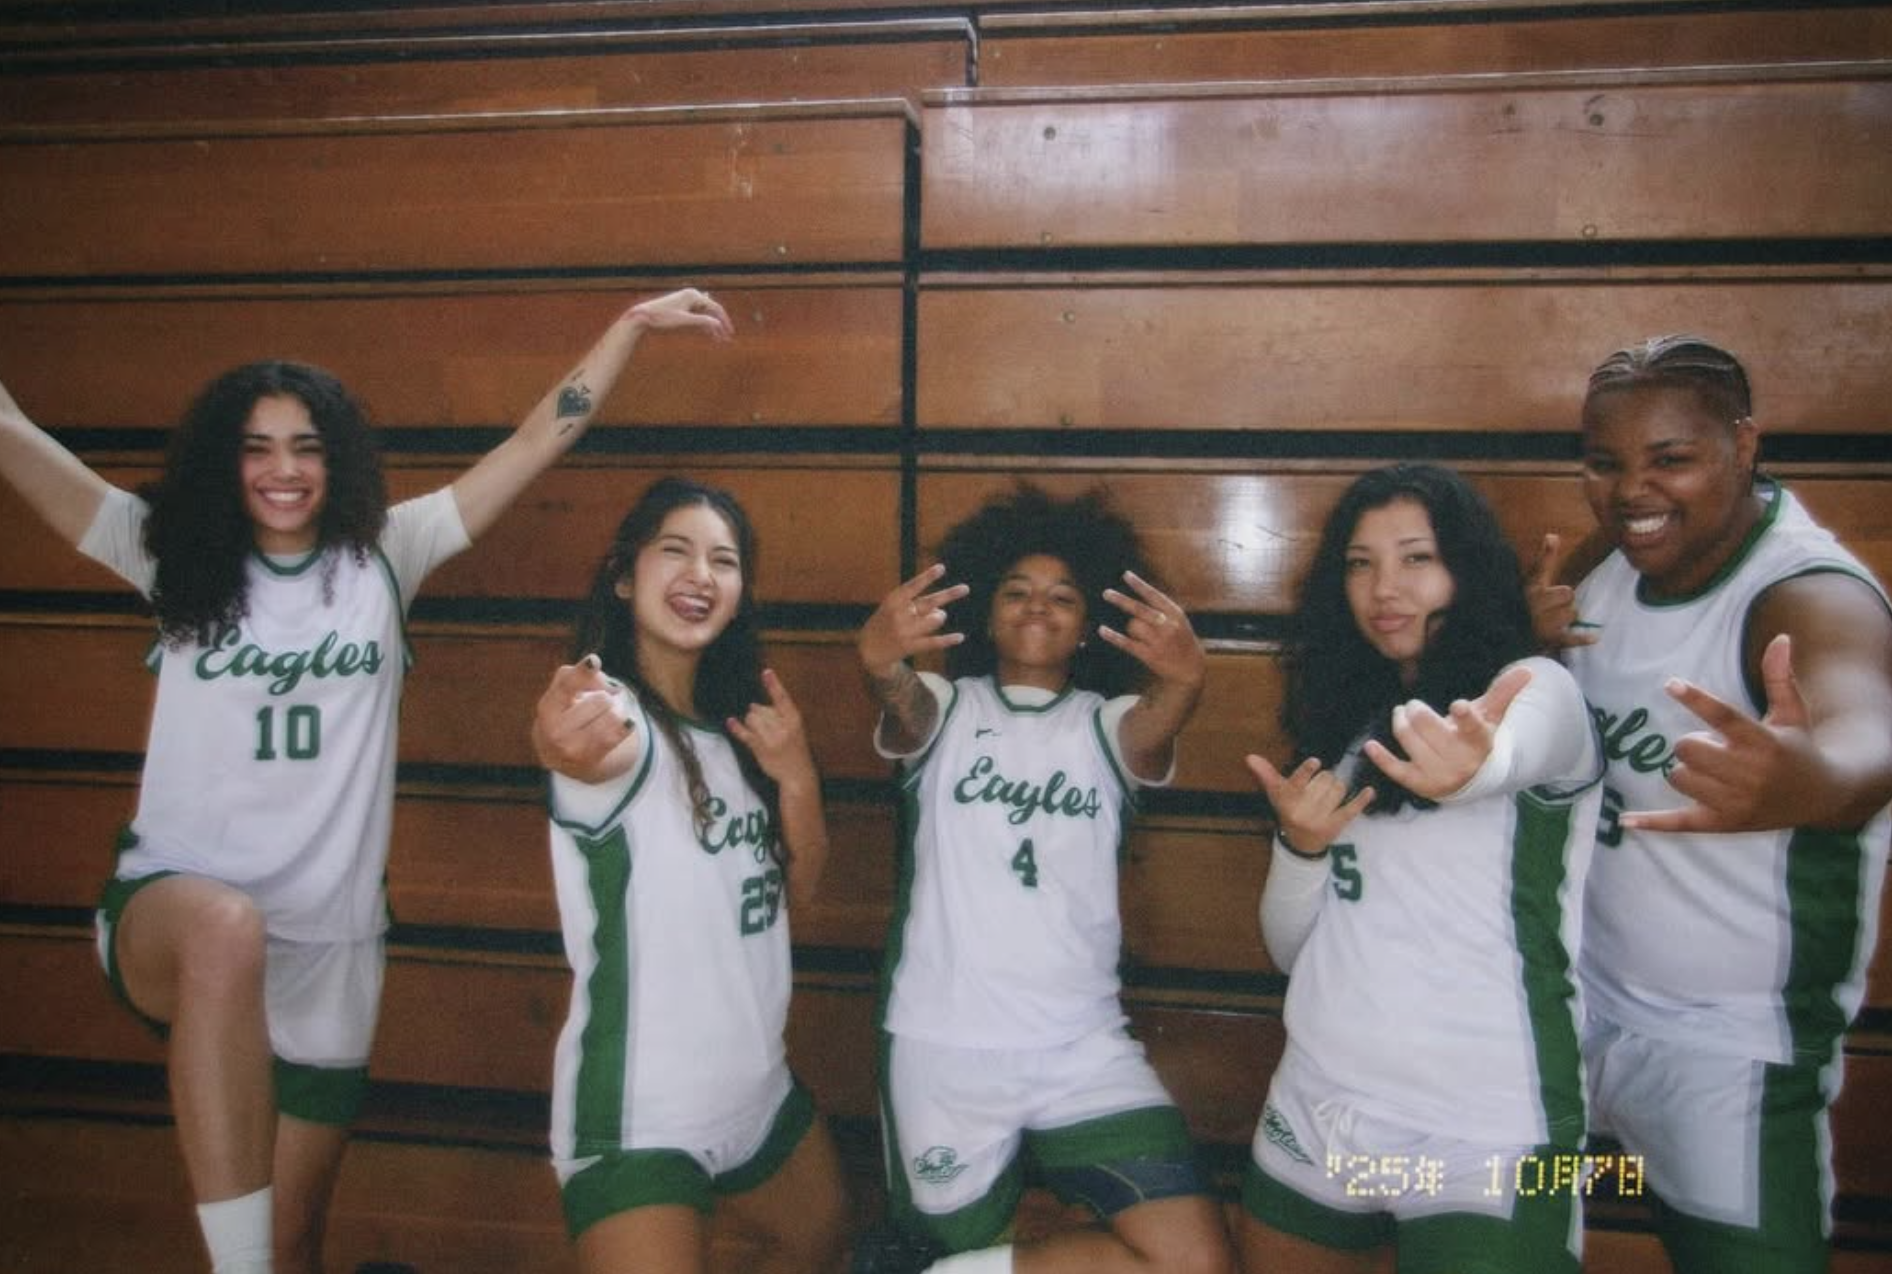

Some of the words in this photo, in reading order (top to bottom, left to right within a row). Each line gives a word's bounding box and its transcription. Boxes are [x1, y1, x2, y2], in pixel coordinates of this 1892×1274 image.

[195, 624, 384, 696] Eagles
[254, 704, 321, 760] 10
[953, 755, 1101, 825] Eagles
[1011, 837, 1038, 888] 4
[1330, 843, 1362, 902] 5
